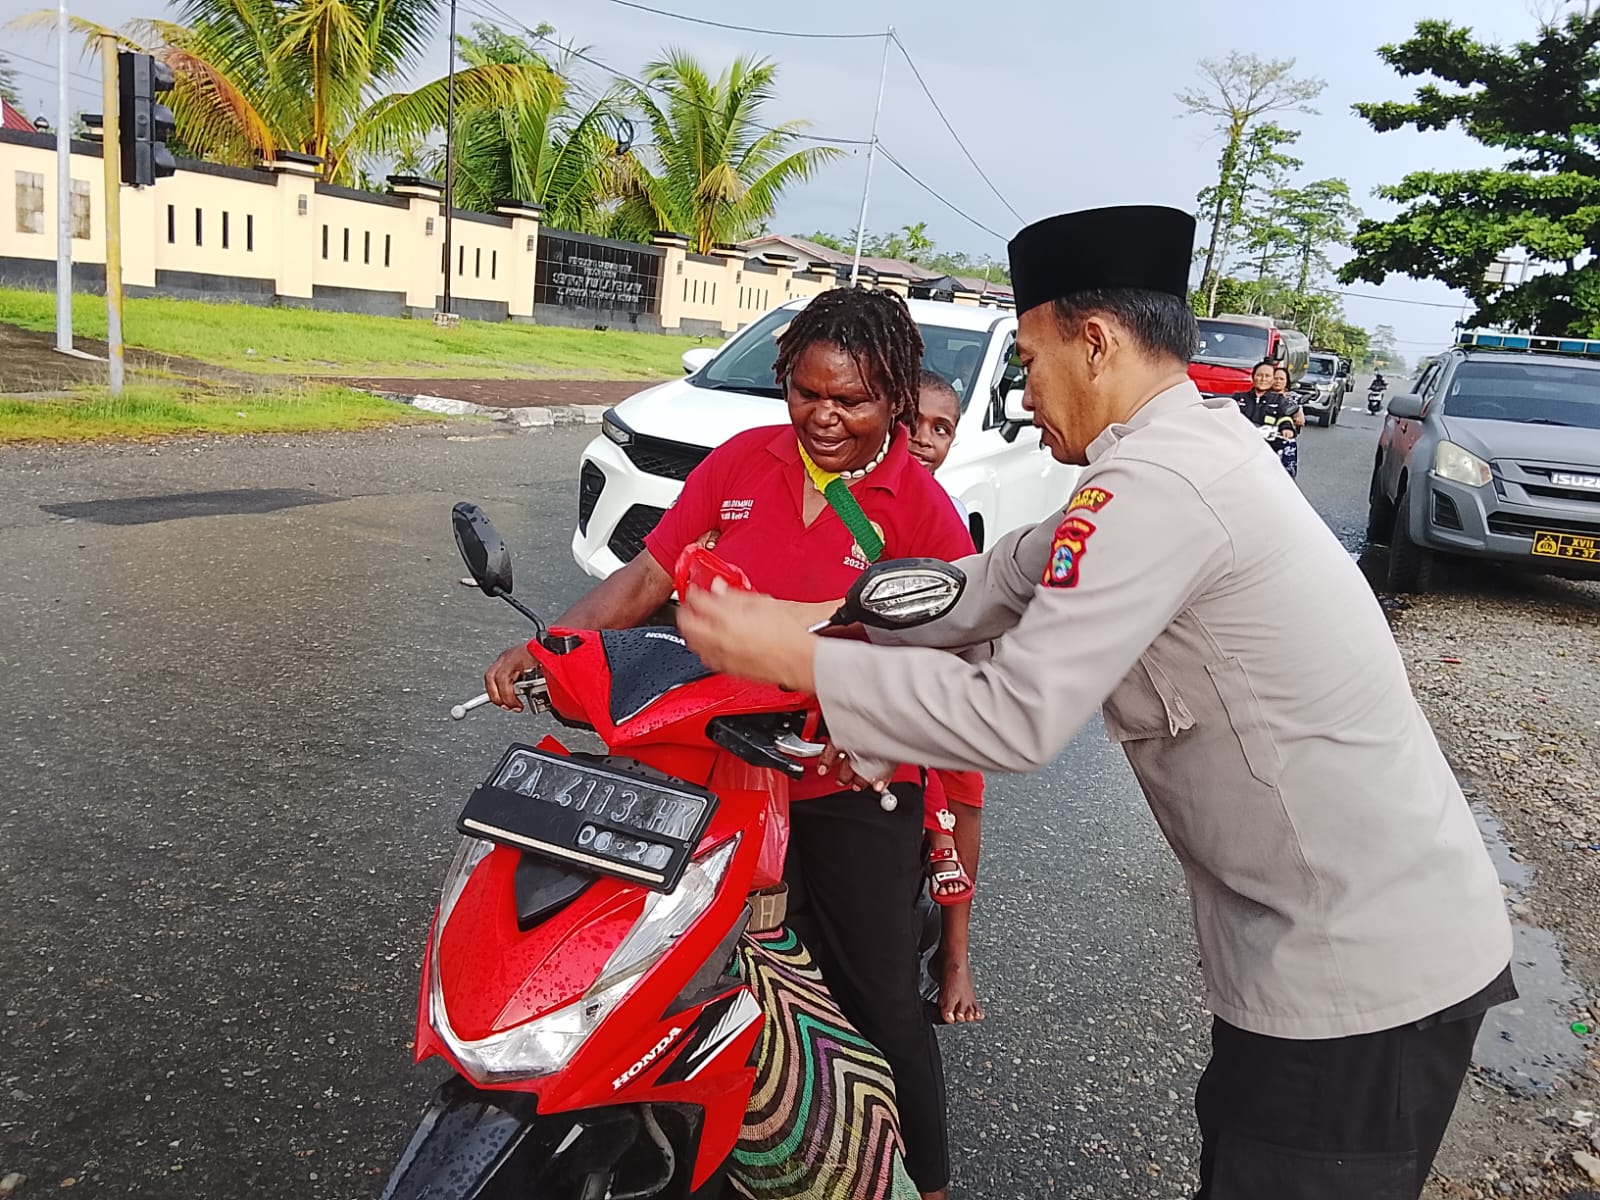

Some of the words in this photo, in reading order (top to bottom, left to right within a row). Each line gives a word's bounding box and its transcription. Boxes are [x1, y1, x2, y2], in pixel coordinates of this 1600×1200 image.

[1572, 538, 1594, 548] XVII
[843, 556, 865, 571] 2022
[644, 632, 686, 646] HONDA
[555, 776, 638, 822] 6113
[612, 1027, 682, 1090] HONDA
